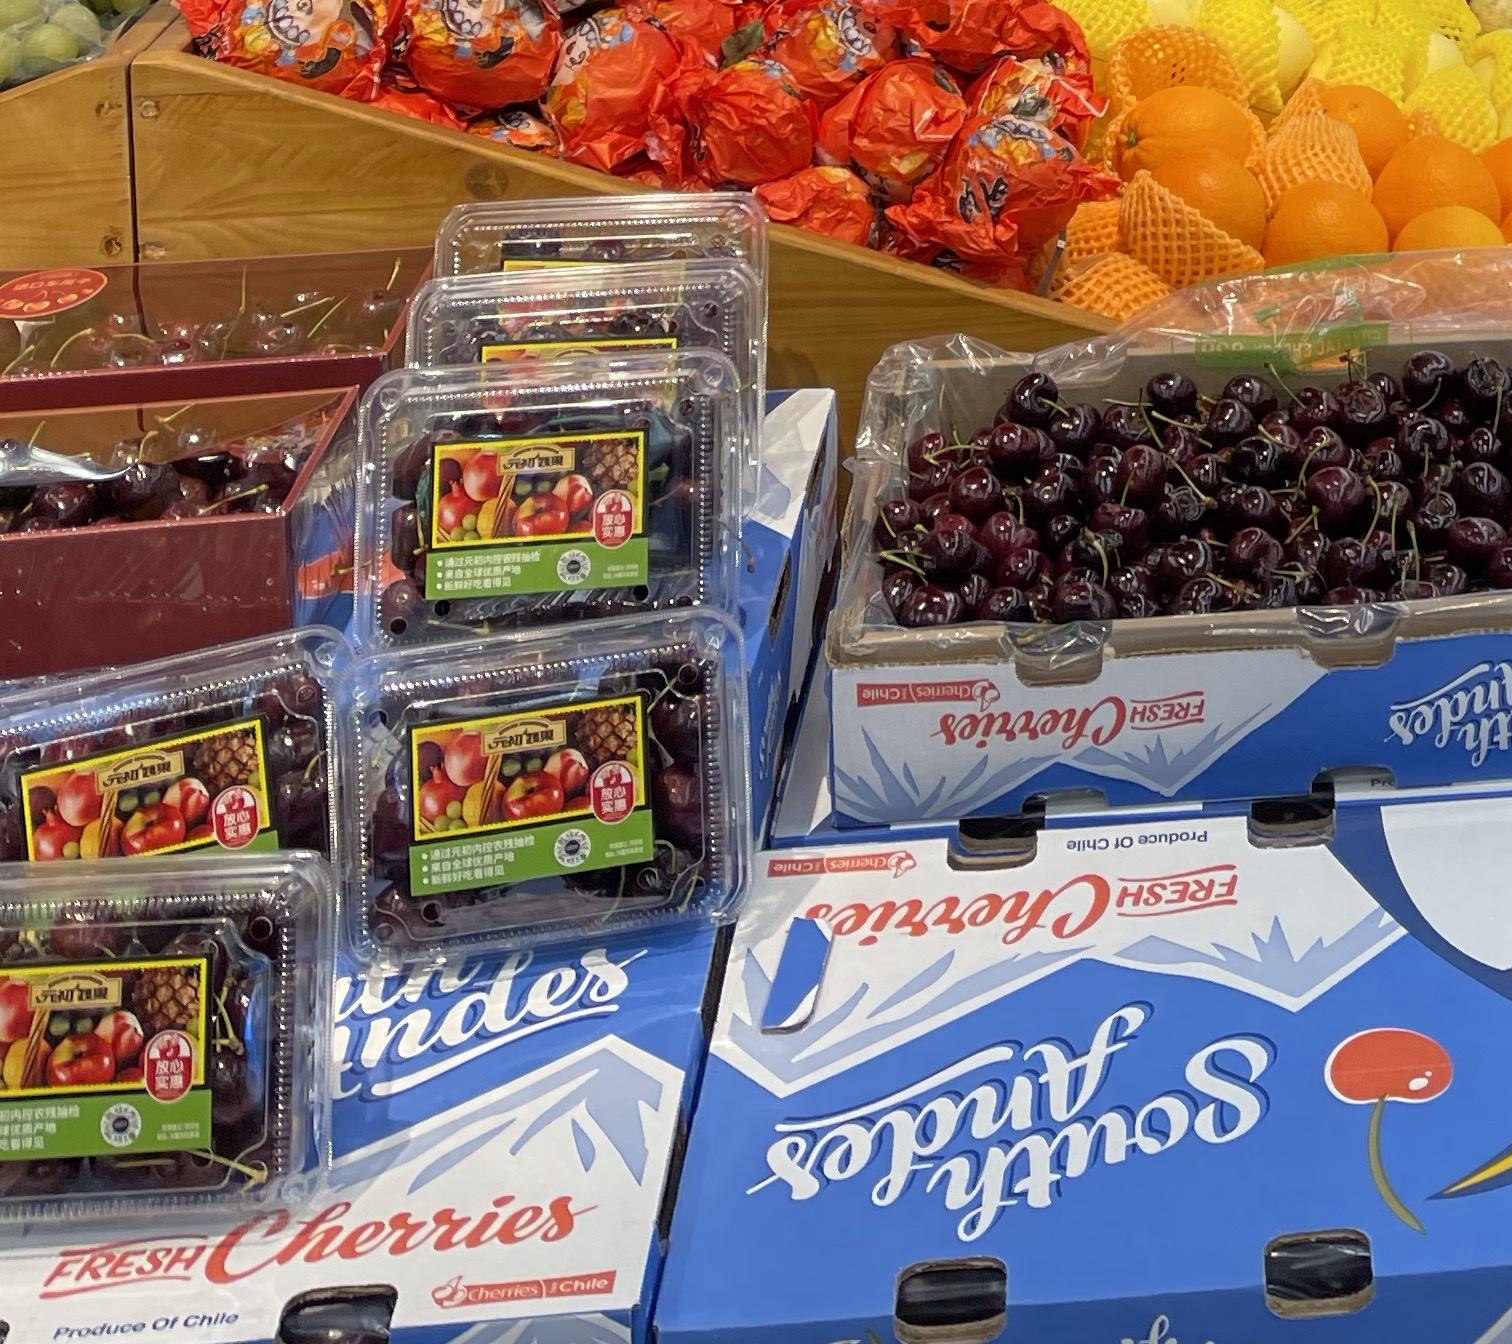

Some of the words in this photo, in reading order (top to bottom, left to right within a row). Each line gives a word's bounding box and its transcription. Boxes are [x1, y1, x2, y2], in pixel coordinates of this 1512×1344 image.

[861, 686, 902, 702] Chile
[915, 681, 974, 700] Cherries
[930, 695, 1128, 750] Cherries
[1129, 695, 1206, 727] FRESH
[1066, 836, 1109, 852] Chile
[1115, 834, 1135, 849] Of
[1137, 830, 1209, 846] Produce
[773, 860, 813, 876] Chile
[827, 855, 888, 873] Cherries
[1115, 869, 1239, 910] FRESH
[806, 872, 1112, 947] Cherries
[746, 1006, 1147, 1207] Andes
[926, 1038, 1270, 1243] South
[43, 1238, 206, 1289] FRESH
[203, 1194, 598, 1285] Cherries
[468, 1286, 539, 1302] Cherries
[559, 1278, 609, 1293] Chile
[53, 1324, 135, 1341] Produce
[140, 1320, 165, 1335] Of
[168, 1312, 240, 1332] Chile
